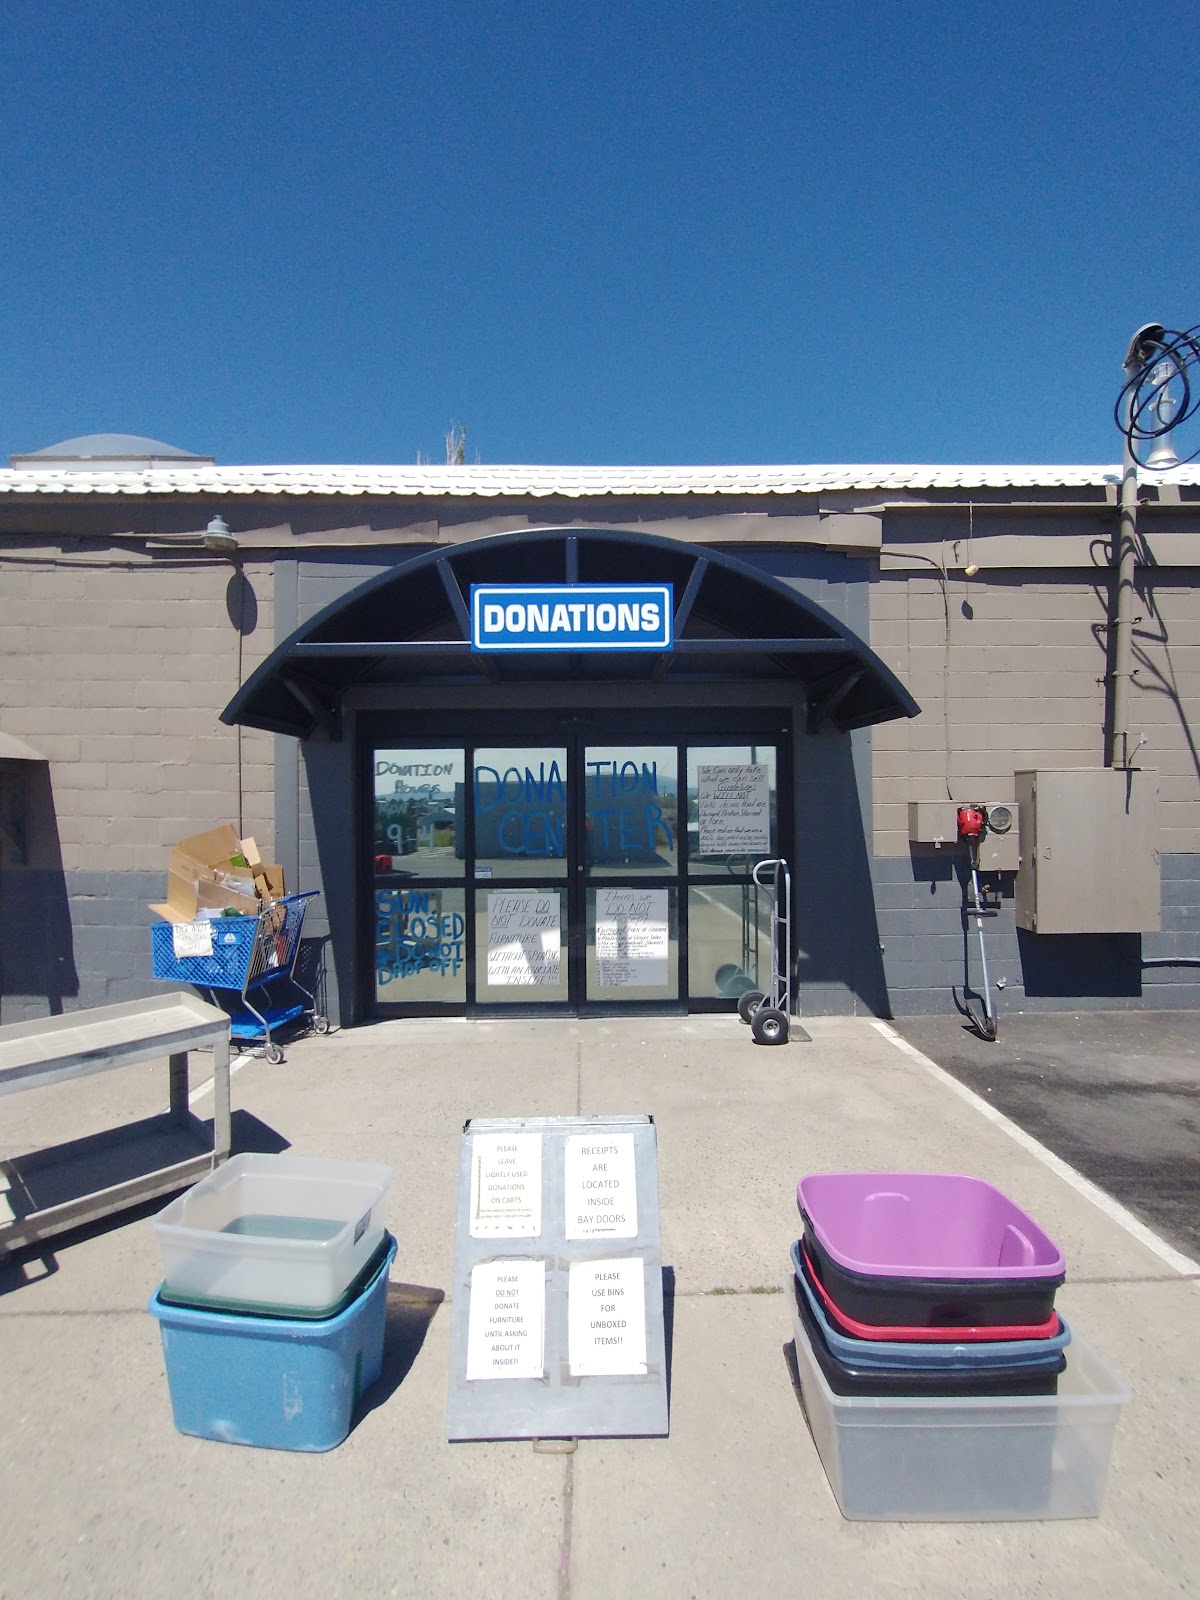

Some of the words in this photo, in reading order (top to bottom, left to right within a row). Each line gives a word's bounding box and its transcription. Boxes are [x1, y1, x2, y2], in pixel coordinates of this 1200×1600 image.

[484, 603, 660, 633] DONATIONS
[375, 761, 453, 776] DONATION
[728, 766, 743, 778] only
[746, 766, 761, 774] take
[492, 898, 533, 913] PLEASE
[535, 900, 551, 914] DO
[606, 903, 625, 915] DO
[628, 902, 655, 915] NOT
[491, 914, 516, 928] NOT
[519, 915, 559, 927] DONATE
[376, 912, 464, 943] CLOSED
[489, 932, 538, 944] FURNITURE
[396, 943, 426, 959] DO
[489, 950, 526, 961] WITHOUT
[377, 960, 424, 986] DROP
[428, 957, 463, 977] OFF
[510, 966, 523, 975] AN
[581, 1146, 618, 1155] RECEIPTS
[592, 1163, 608, 1171] ARE
[488, 1183, 525, 1191] DONATIONS
[582, 1179, 620, 1189] LOCATED
[490, 1196, 501, 1204] ON
[502, 1196, 522, 1204] CARTS
[587, 1197, 615, 1206] INSIDE
[577, 1215, 594, 1224] BAY
[596, 1214, 626, 1224] DOORS
[594, 1272, 621, 1281] PLEASE
[496, 1288, 505, 1296] DO
[506, 1288, 519, 1296] NOT
[592, 1288, 606, 1297] USE
[608, 1287, 625, 1296] BINS
[494, 1302, 520, 1310] DONATE
[600, 1304, 616, 1312] FOR
[489, 1316, 524, 1324] FURNITURE
[590, 1319, 627, 1329] UNBOXED
[484, 1329, 503, 1338] UNTIL
[504, 1329, 528, 1337] ASKING
[594, 1336, 623, 1345] ITEMS!!
[491, 1344, 512, 1352] ABOUT
[514, 1343, 520, 1351] IT
[492, 1357, 519, 1366] INSIDE!!
